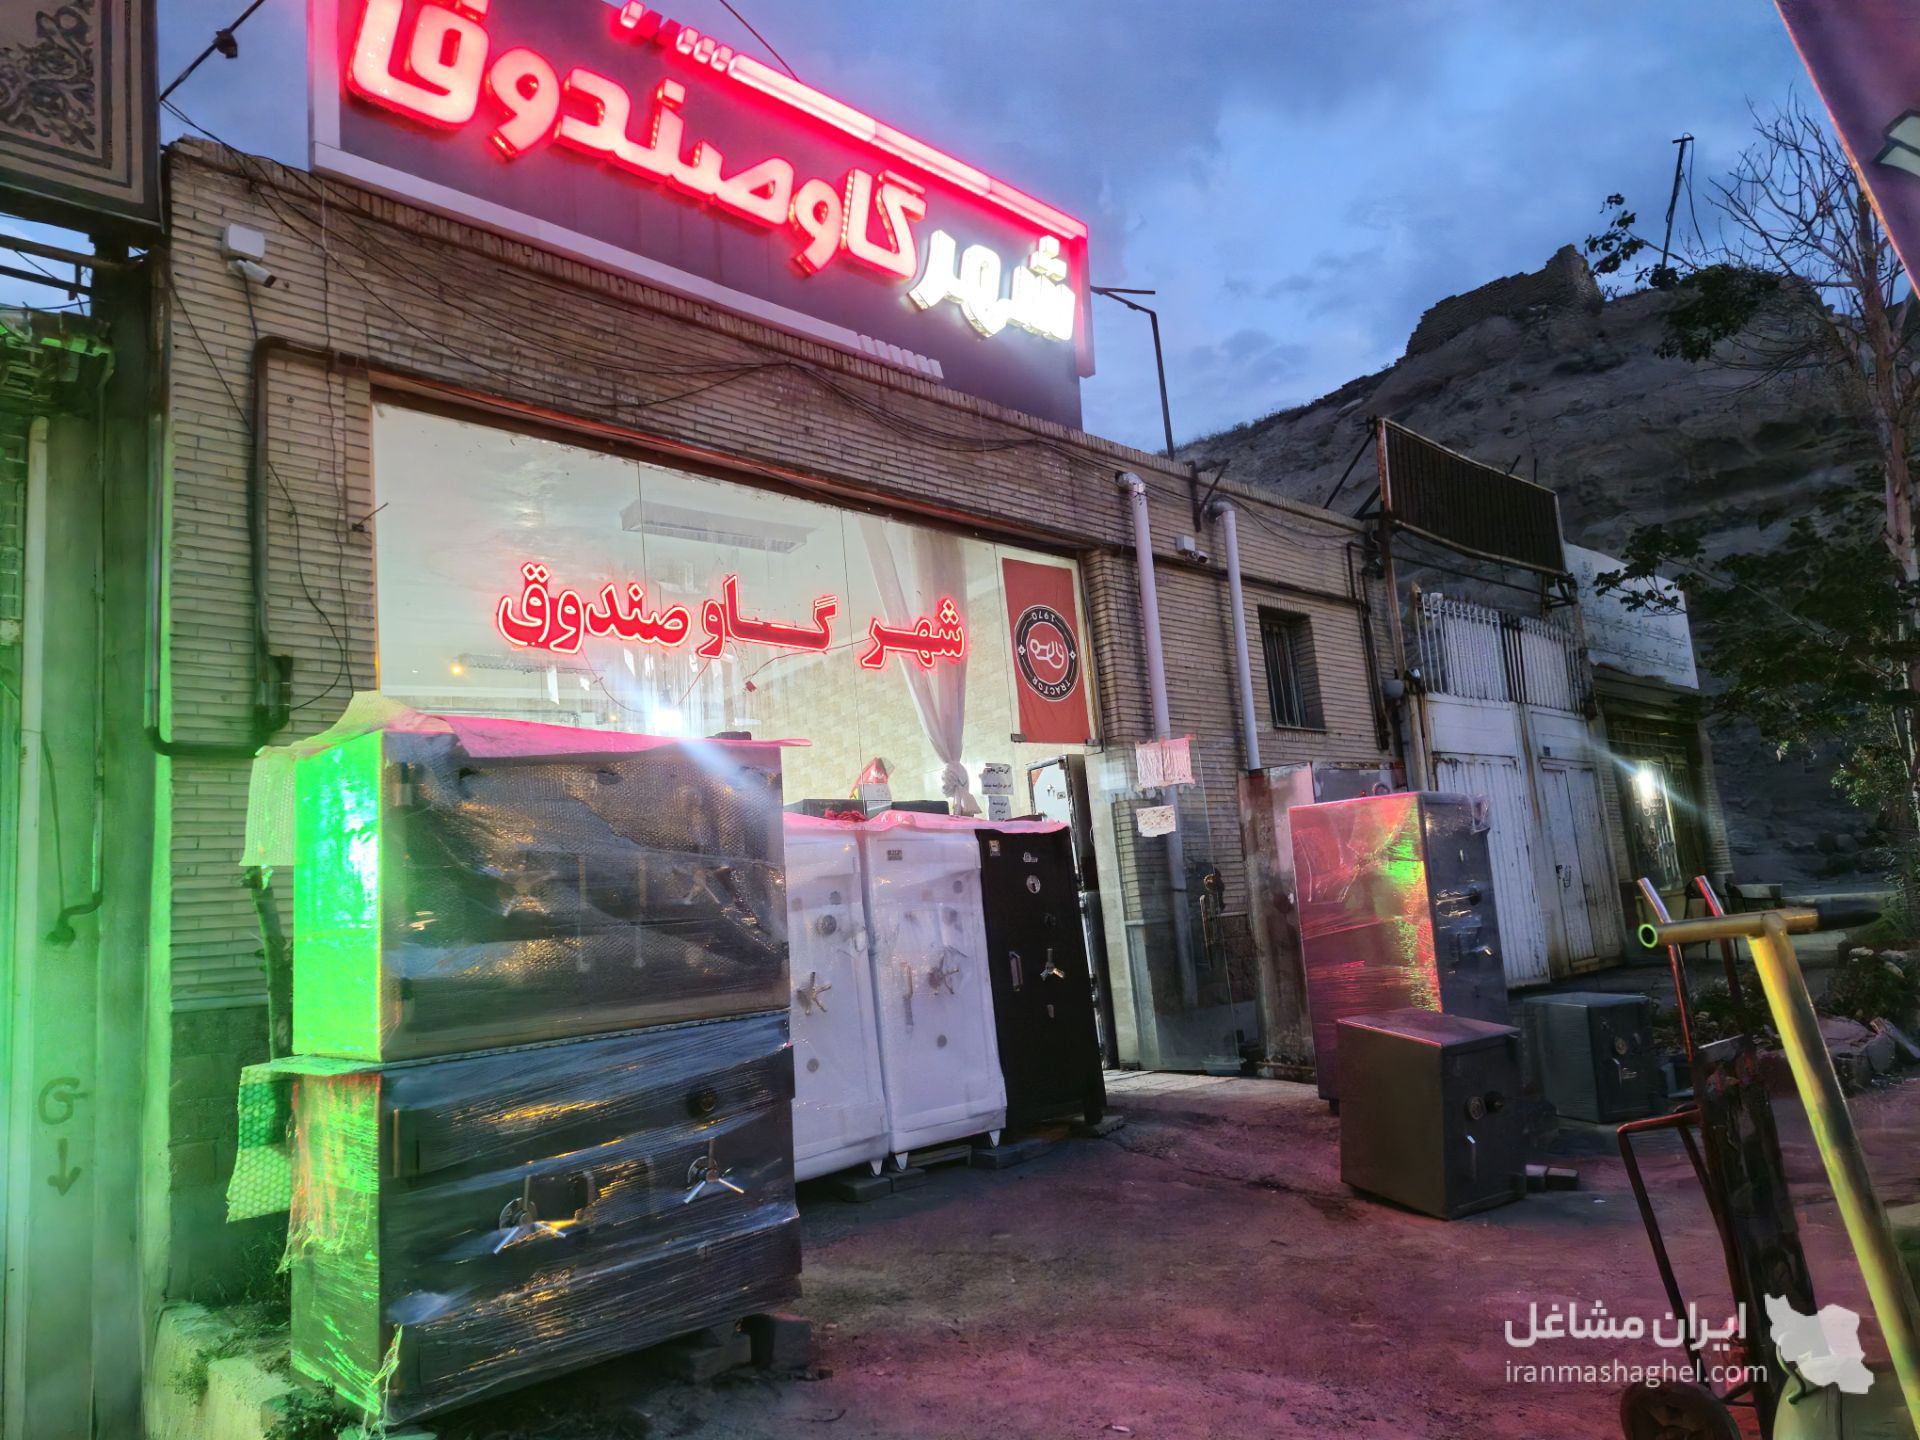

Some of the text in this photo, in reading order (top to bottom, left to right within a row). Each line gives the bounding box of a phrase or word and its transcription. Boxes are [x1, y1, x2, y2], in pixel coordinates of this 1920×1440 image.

[907, 230, 1076, 342] شهر
[861, 599, 965, 668] شهر
[1031, 610, 1056, 622] 1970
[1032, 676, 1071, 696] TRACTOR
